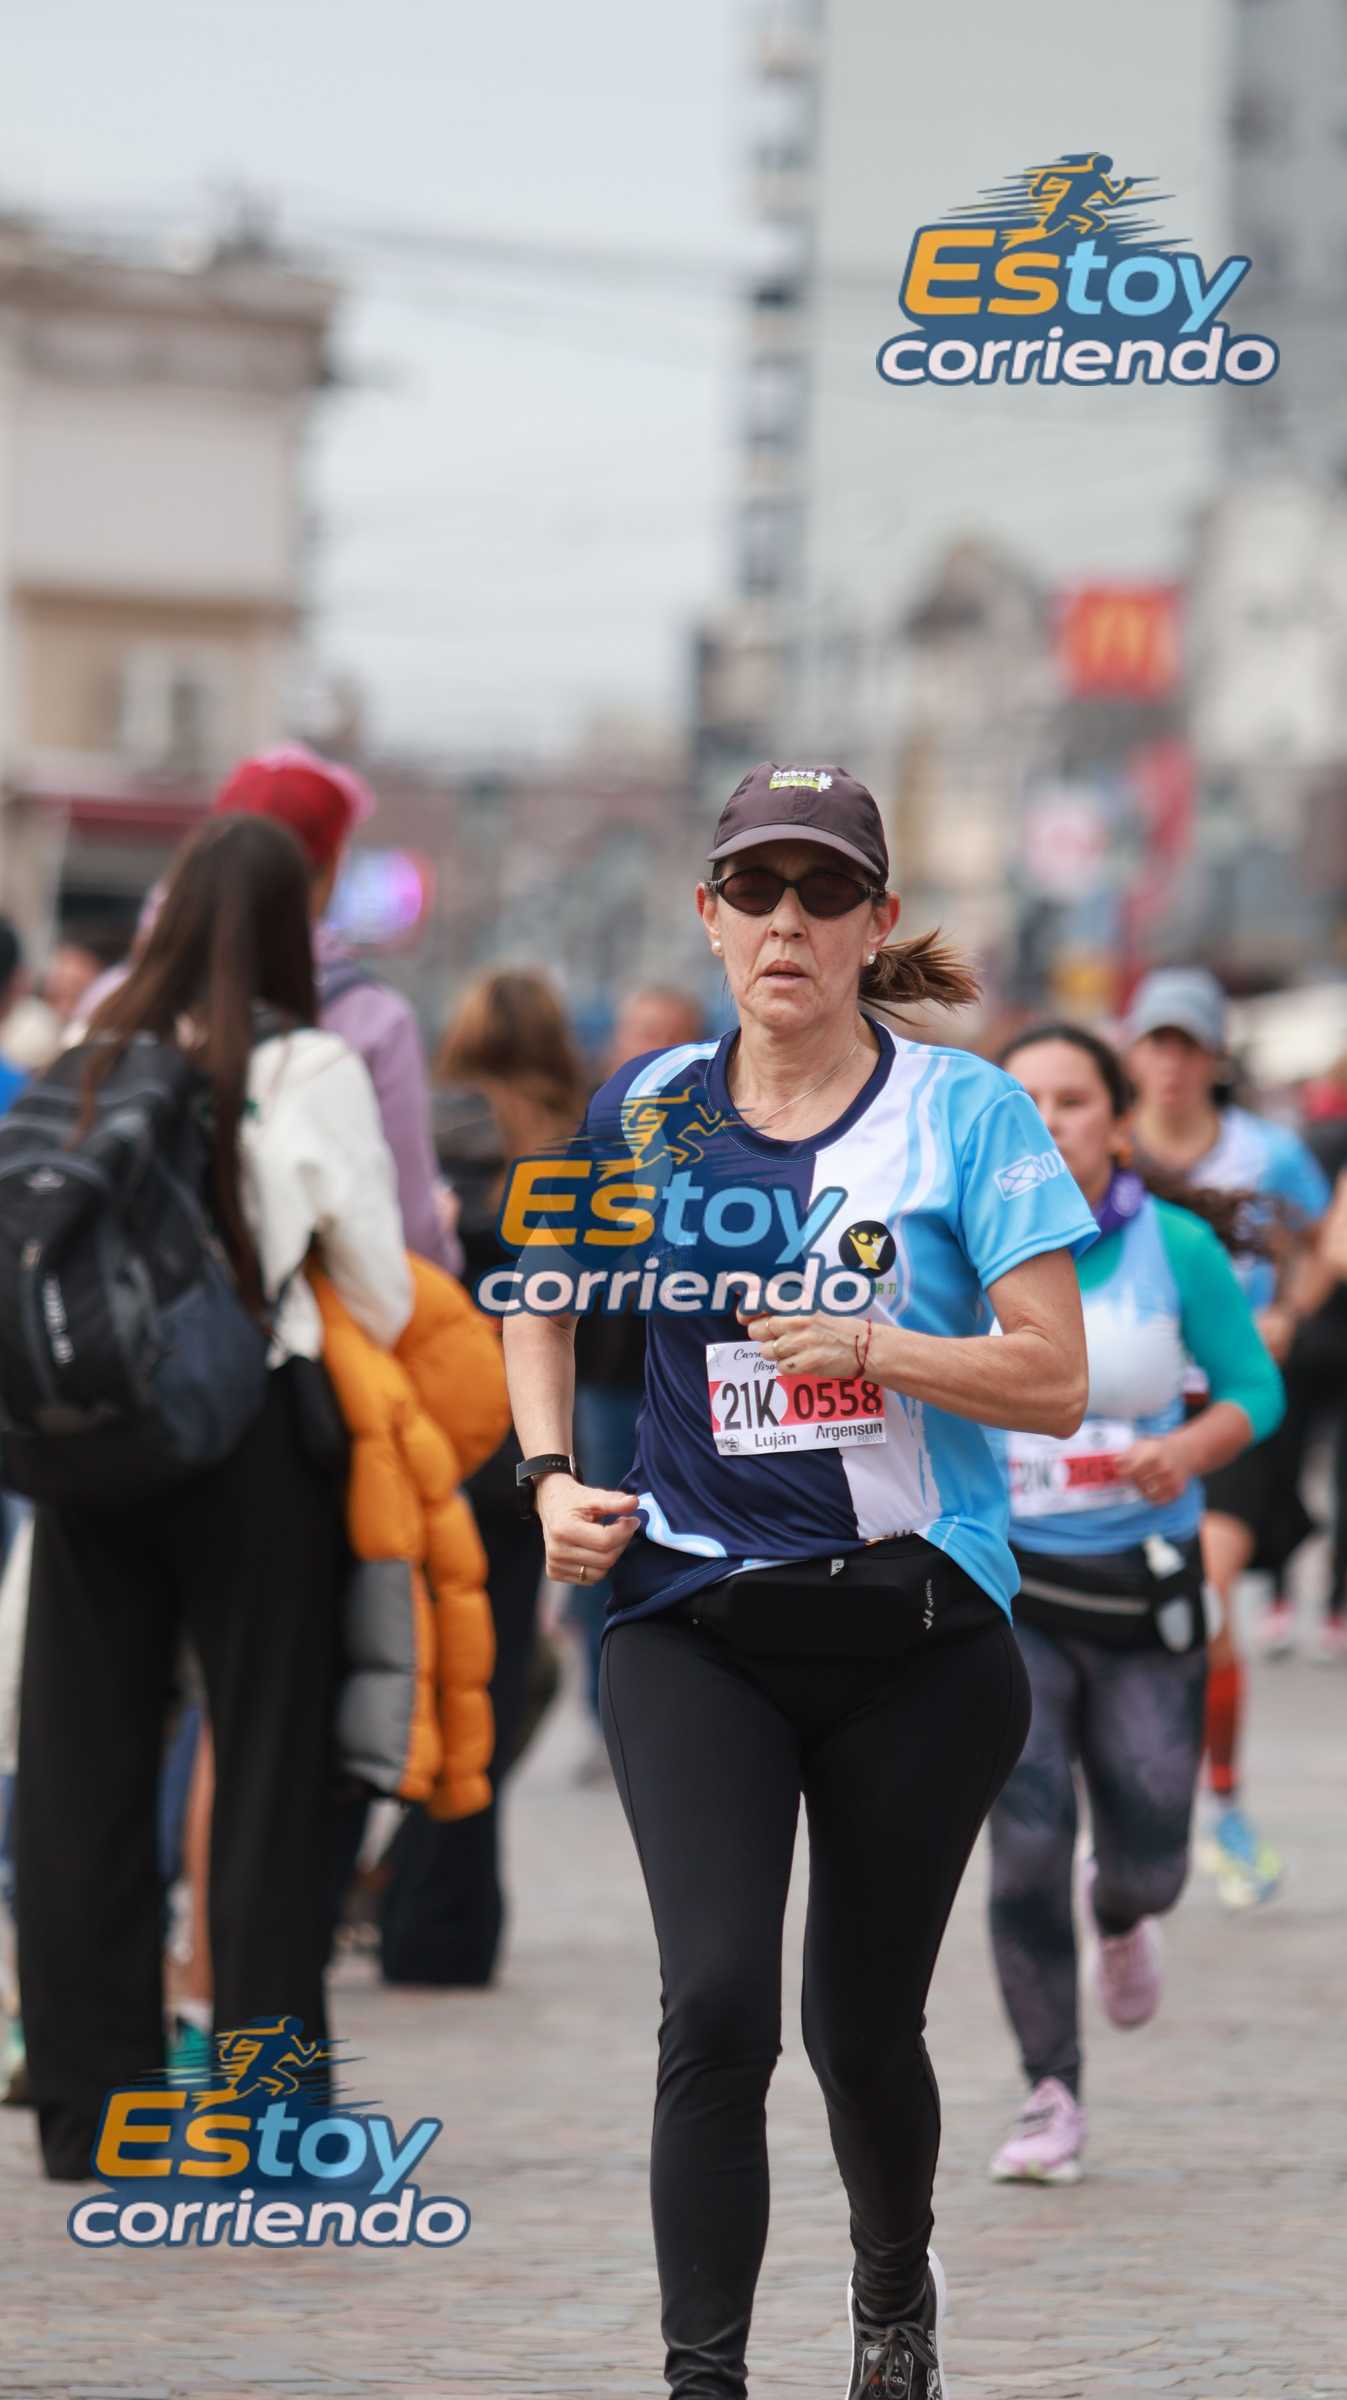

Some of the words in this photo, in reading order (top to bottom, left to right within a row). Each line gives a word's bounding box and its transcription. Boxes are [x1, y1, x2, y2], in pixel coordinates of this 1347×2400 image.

[753, 1361, 777, 1374] Virg
[721, 1378, 780, 1431] 21K
[793, 1379, 882, 1420] 0558
[755, 1431, 797, 1450] Luján
[816, 1422, 882, 1441] Argensun
